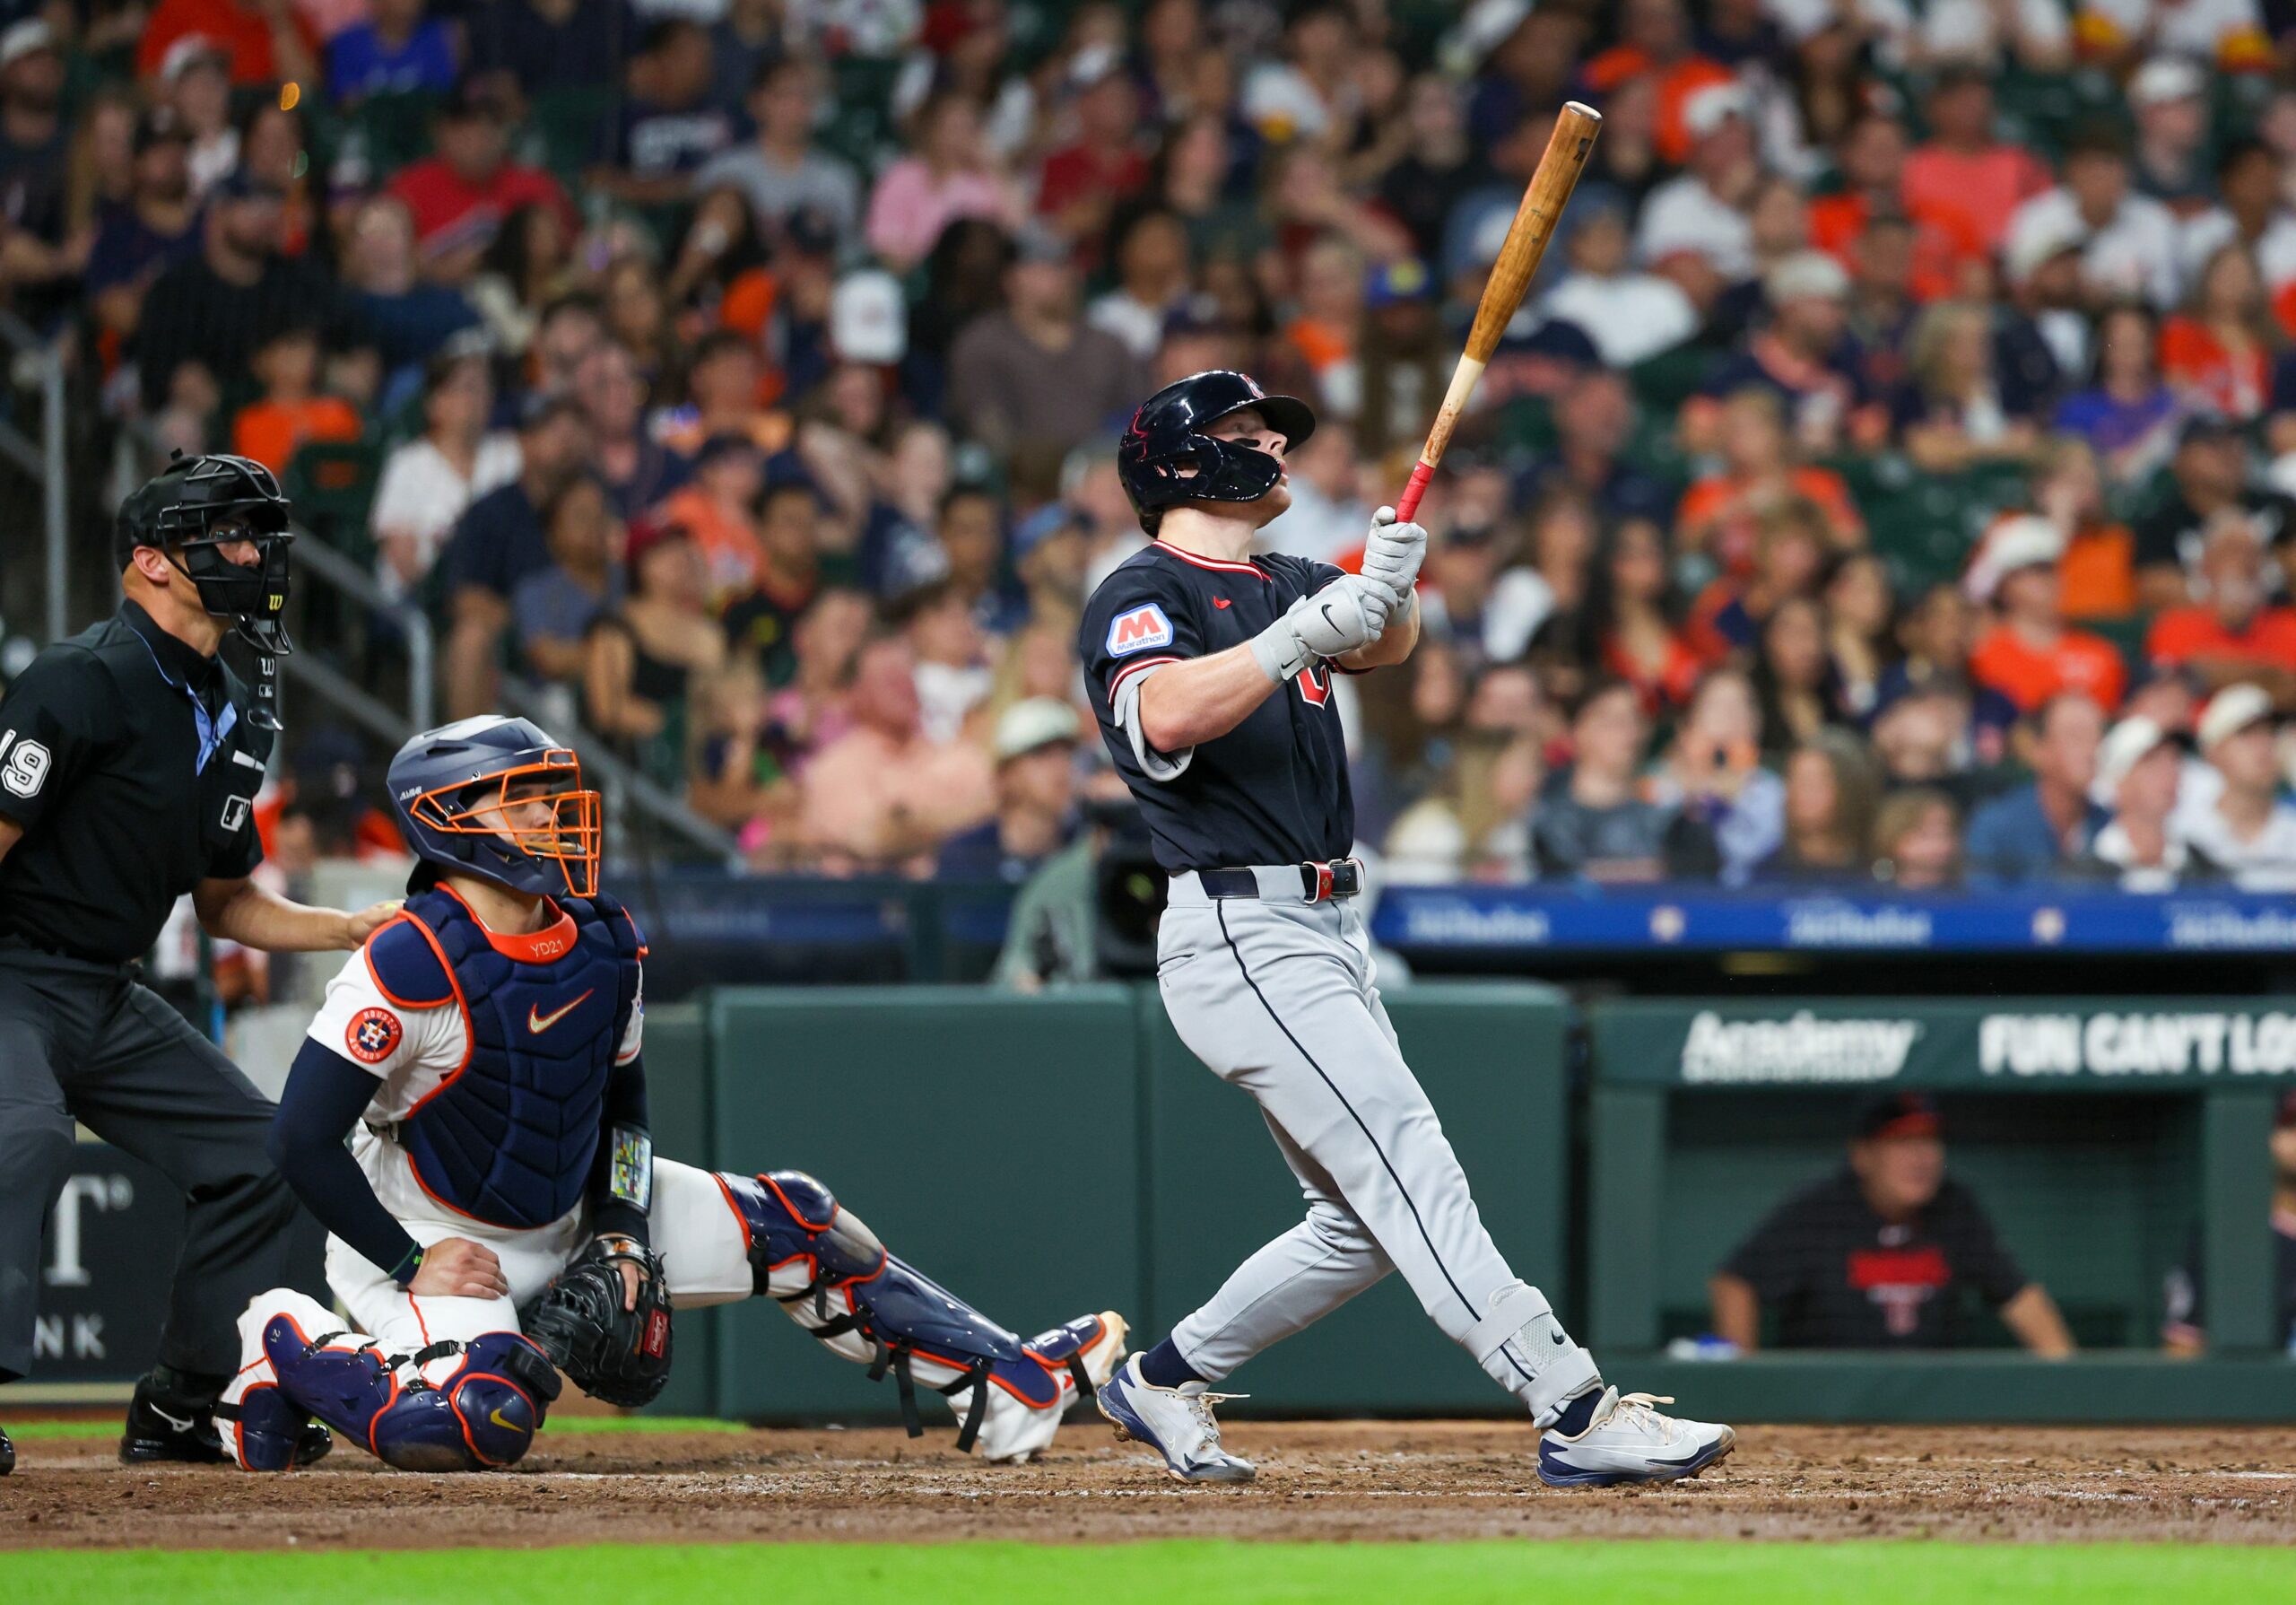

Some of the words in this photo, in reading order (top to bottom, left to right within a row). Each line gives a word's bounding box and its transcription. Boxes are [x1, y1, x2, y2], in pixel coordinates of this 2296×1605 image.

[1117, 610, 1161, 644] M
[1117, 634, 1165, 651] Marathon
[530, 939, 564, 958] YD21
[1979, 1013, 2082, 1077] FUN
[2084, 1012, 2226, 1077] CAN'T
[2229, 1012, 2296, 1077] LO
